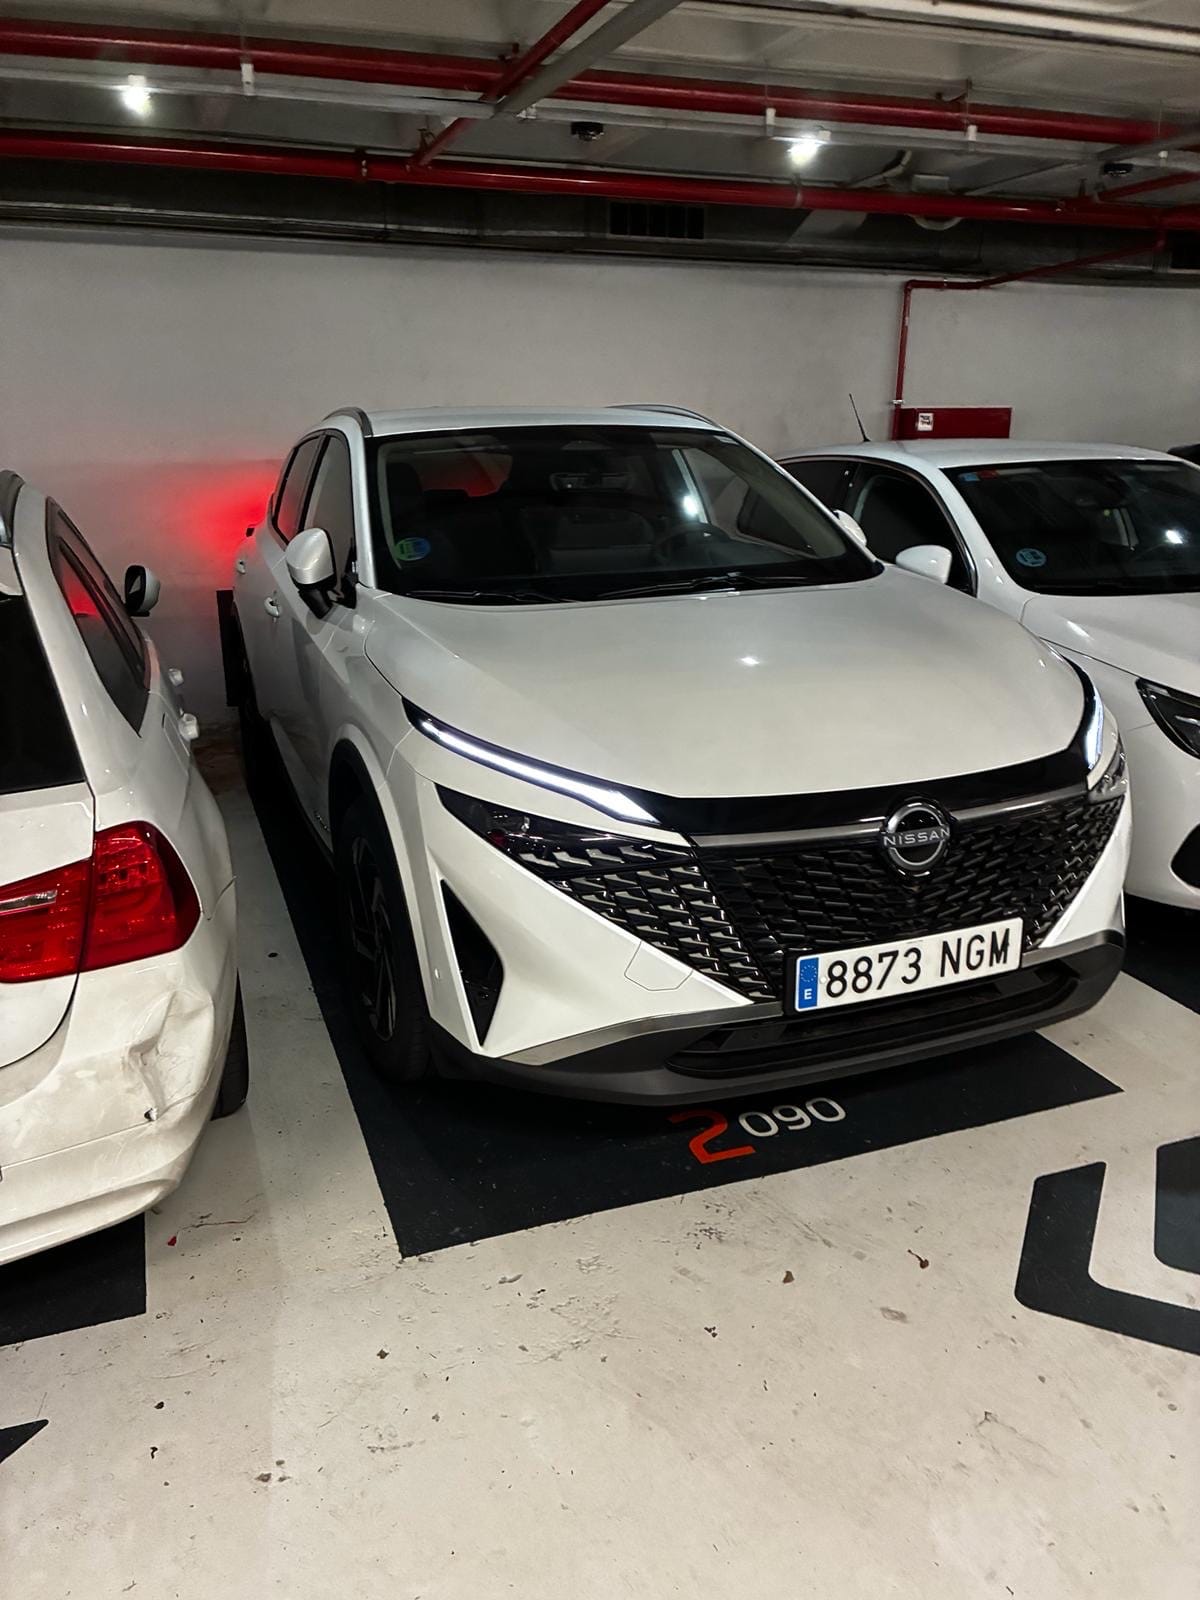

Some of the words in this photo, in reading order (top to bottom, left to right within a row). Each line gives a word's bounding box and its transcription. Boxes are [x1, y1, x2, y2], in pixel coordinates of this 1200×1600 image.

[883, 826, 950, 846] NISSAN
[803, 988, 812, 1000] E
[826, 947, 922, 998] 8873
[940, 928, 1010, 977] NGM
